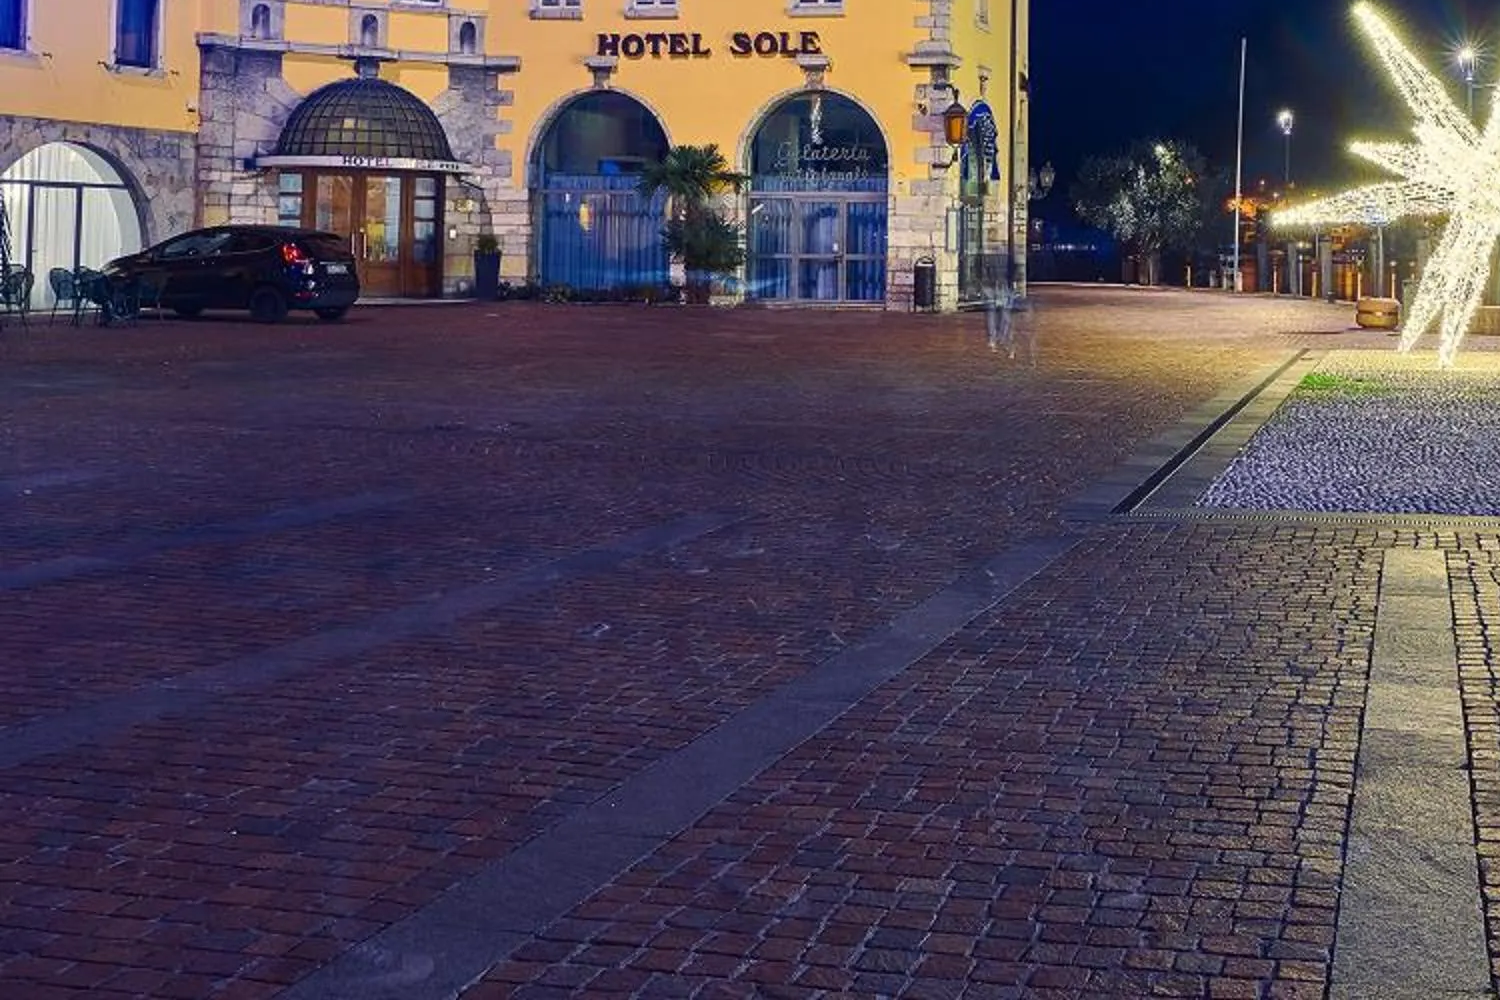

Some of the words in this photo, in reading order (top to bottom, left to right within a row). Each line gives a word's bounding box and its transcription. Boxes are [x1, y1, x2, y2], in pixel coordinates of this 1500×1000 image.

[597, 33, 711, 58] HOTEL
[730, 31, 822, 57] SOLE
[342, 155, 389, 168] HOTEL
